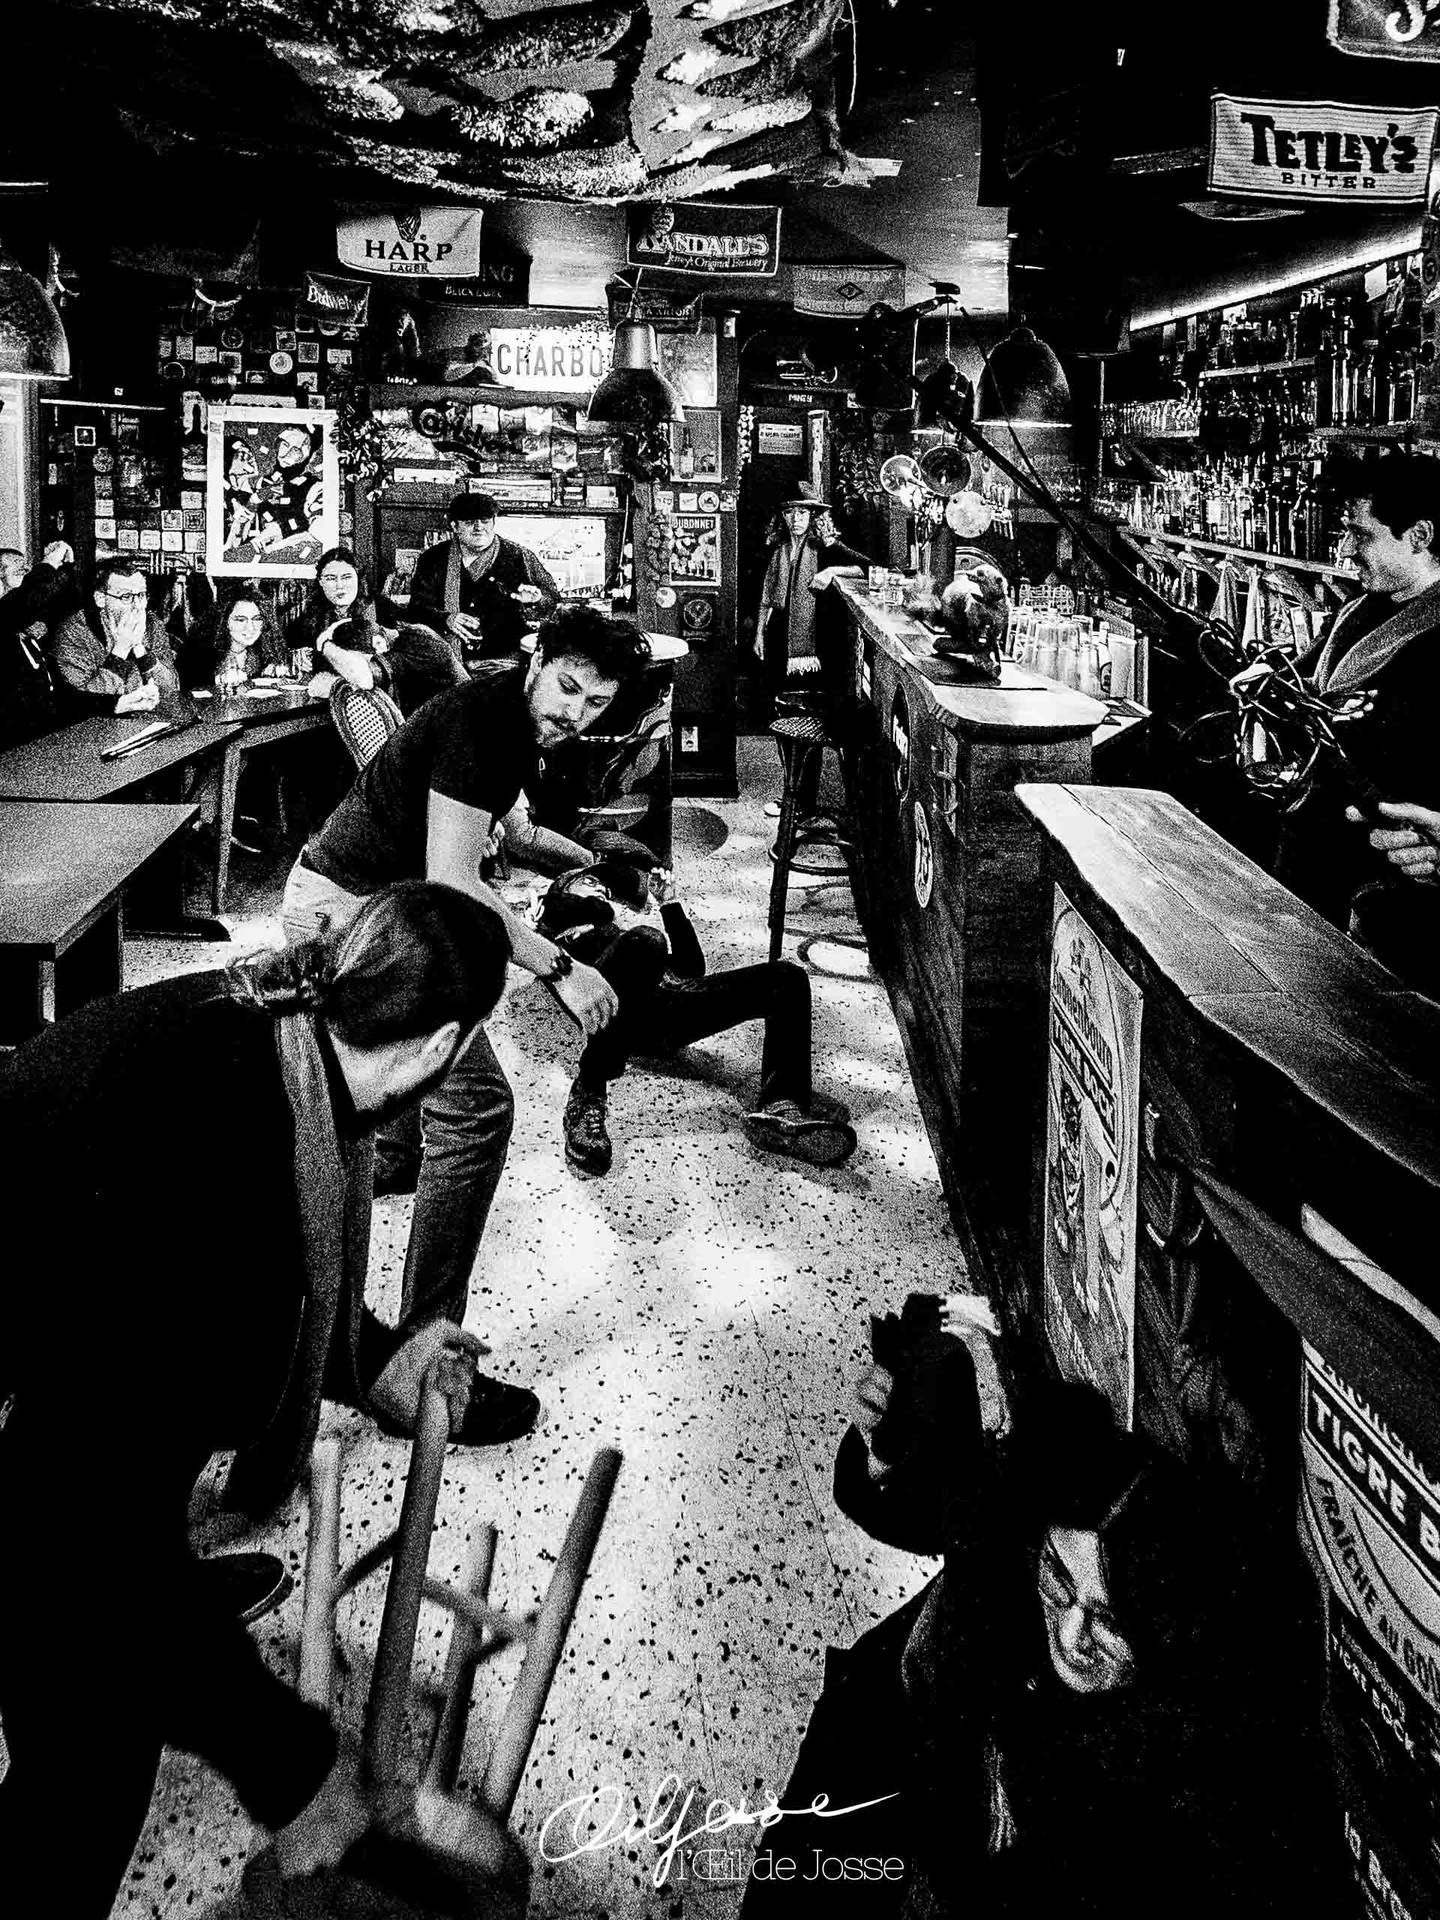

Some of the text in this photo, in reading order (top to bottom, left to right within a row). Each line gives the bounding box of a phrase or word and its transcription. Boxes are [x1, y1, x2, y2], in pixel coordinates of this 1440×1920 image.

[1241, 112, 1418, 173] TETLEY'S
[1281, 172, 1376, 189] BITTER
[364, 239, 453, 263] HARP
[390, 262, 429, 273] LAGER
[694, 256, 730, 271] Original
[673, 518, 715, 530] DUBONNET
[1312, 1390, 1407, 1525] TIGRE
